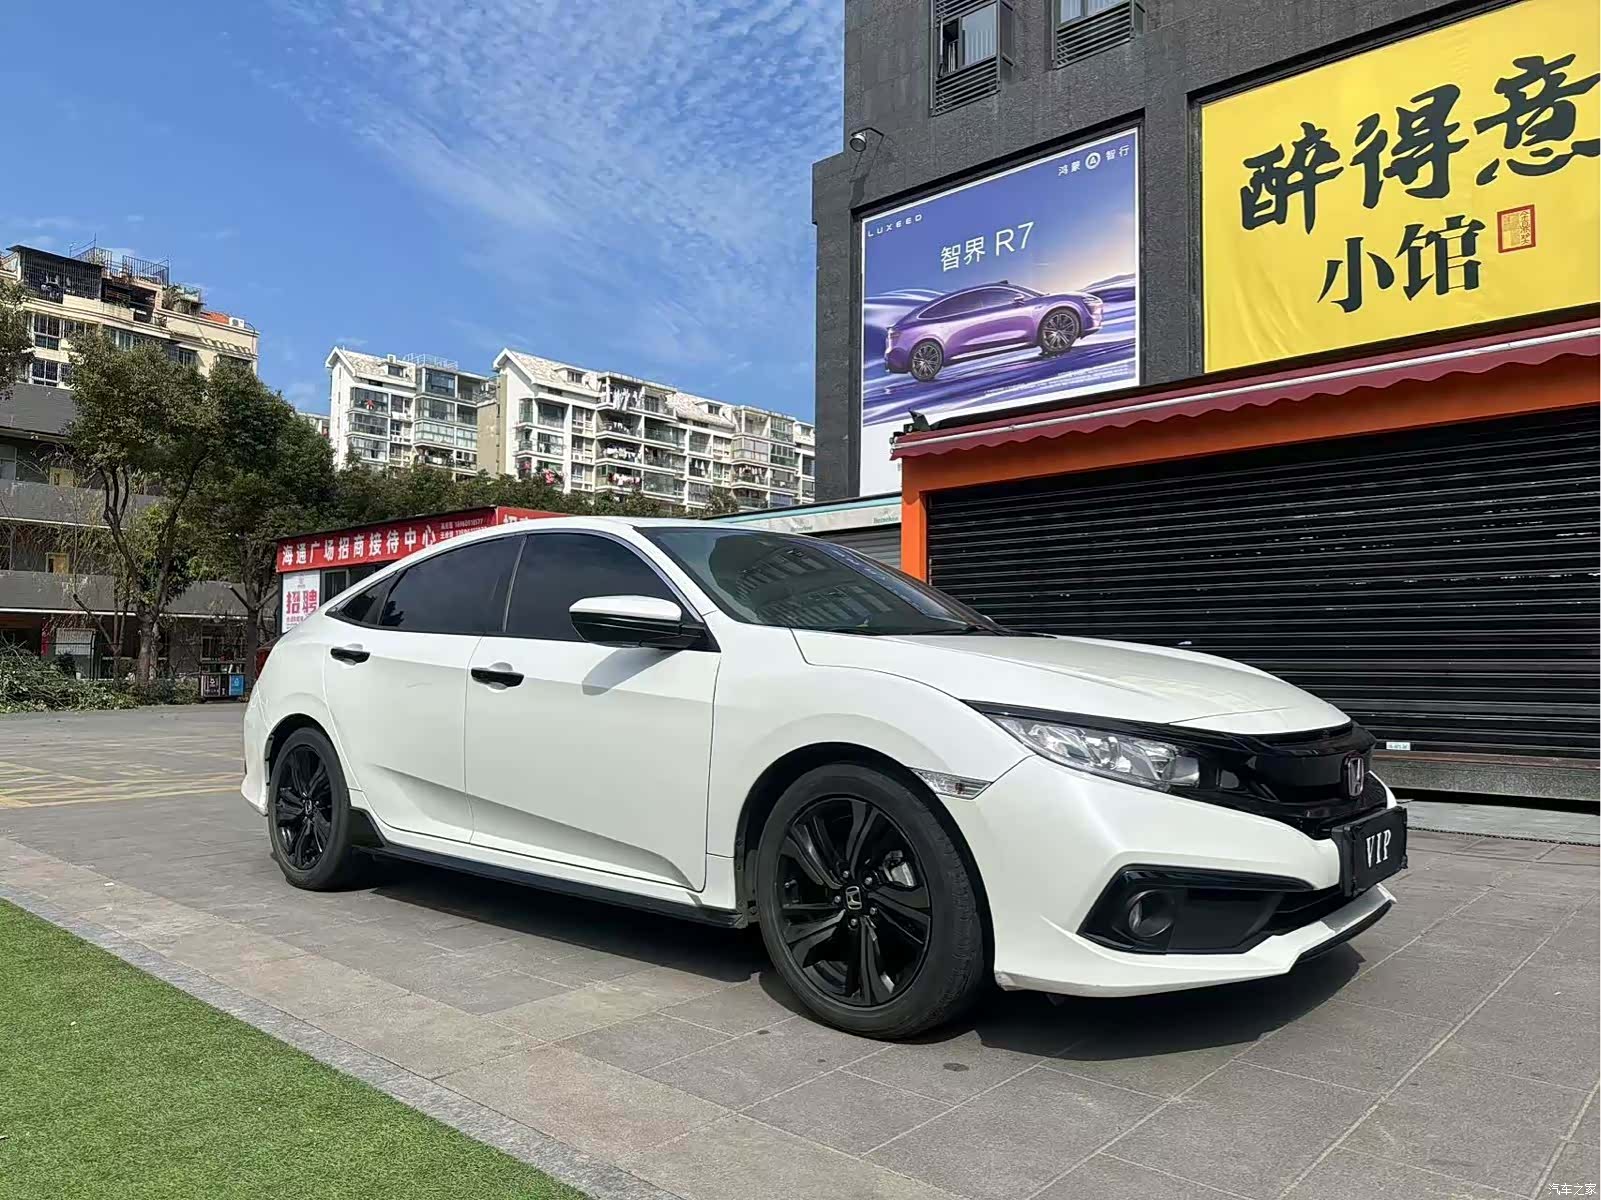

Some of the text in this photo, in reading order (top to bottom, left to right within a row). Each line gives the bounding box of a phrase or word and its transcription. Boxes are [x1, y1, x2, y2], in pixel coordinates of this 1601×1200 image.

[1058, 145, 1130, 176] 鸿蒙 智行
[1240, 53, 1600, 235] 醉得意
[867, 214, 923, 237] LUXEED
[940, 221, 1035, 272] 智界 R7
[1317, 214, 1486, 313] 小馆
[281, 524, 437, 567] 海通广场招商接待中心
[286, 589, 318, 615] 招聘
[1365, 829, 1392, 869] VIP
